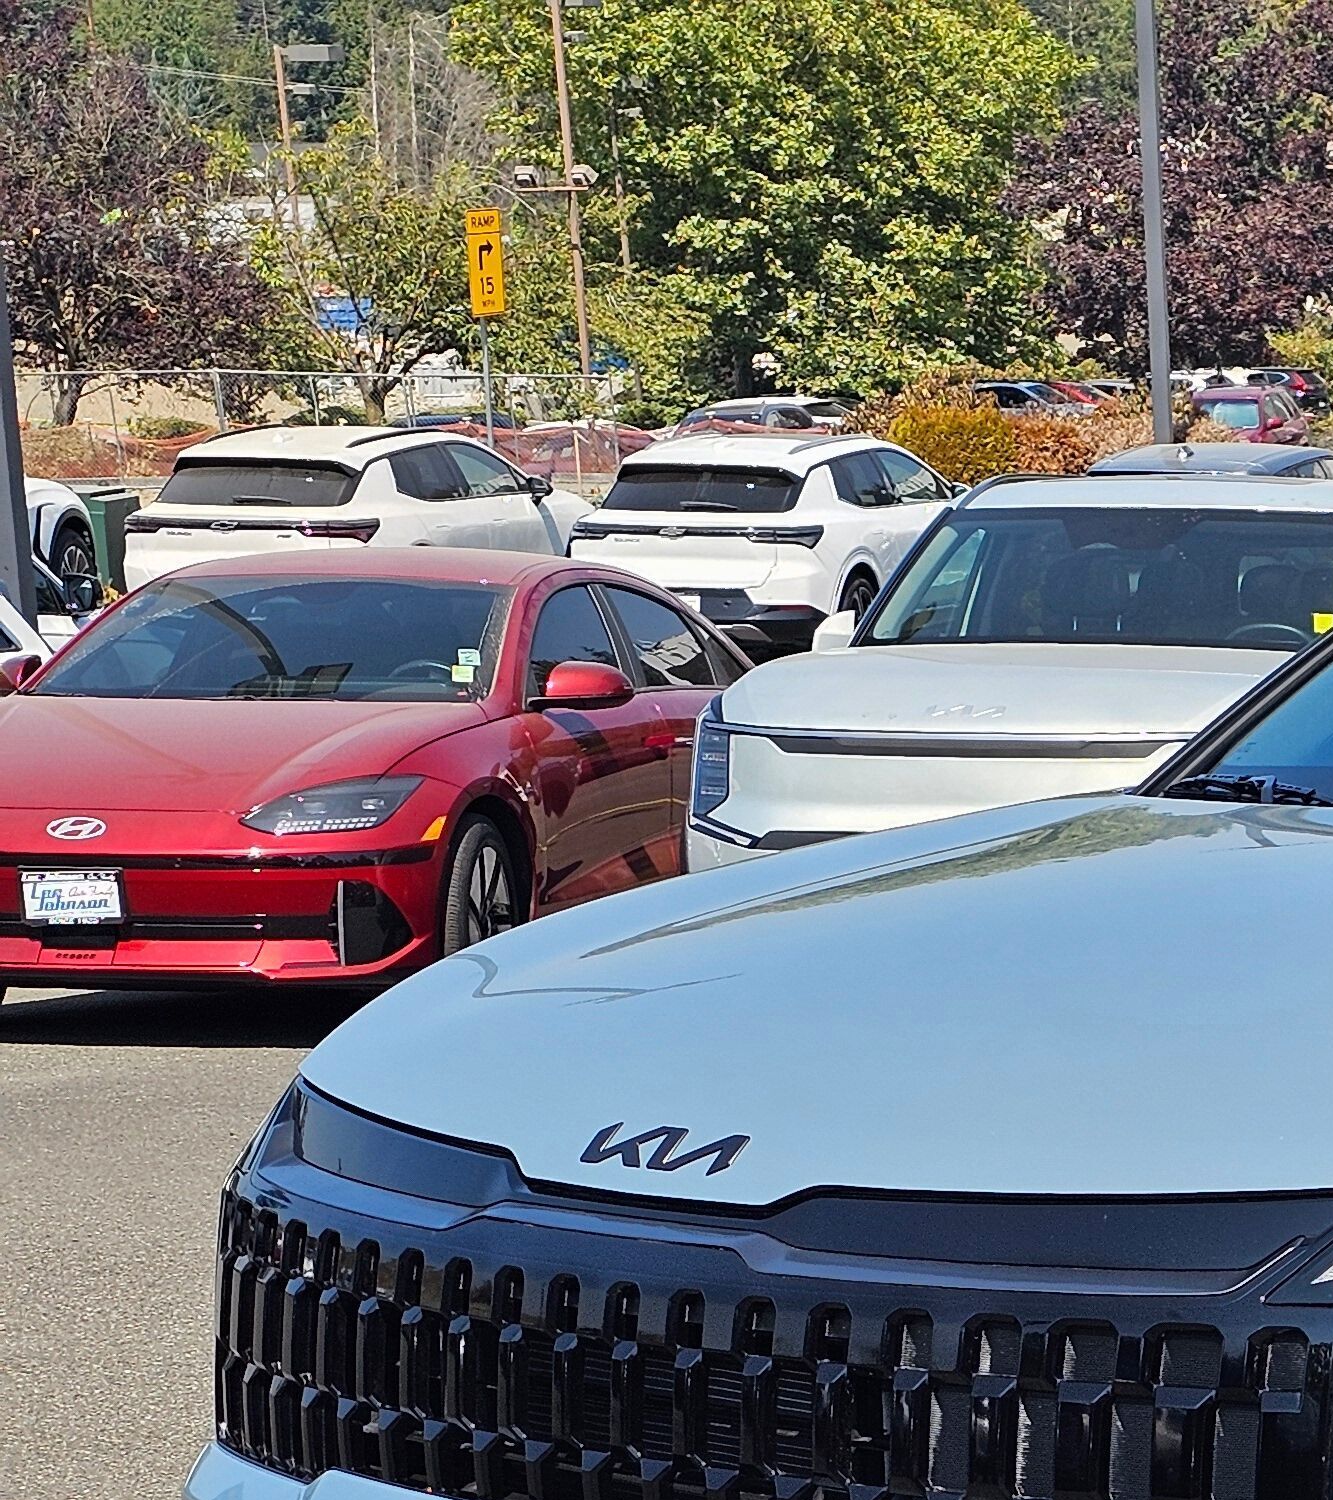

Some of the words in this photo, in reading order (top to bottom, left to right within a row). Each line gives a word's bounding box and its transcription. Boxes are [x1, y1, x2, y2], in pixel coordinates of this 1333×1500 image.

[470, 215, 495, 228] RAMP
[480, 276, 495, 295] 15
[34, 889, 111, 911] Johnson
[579, 1121, 751, 1176] KIA
